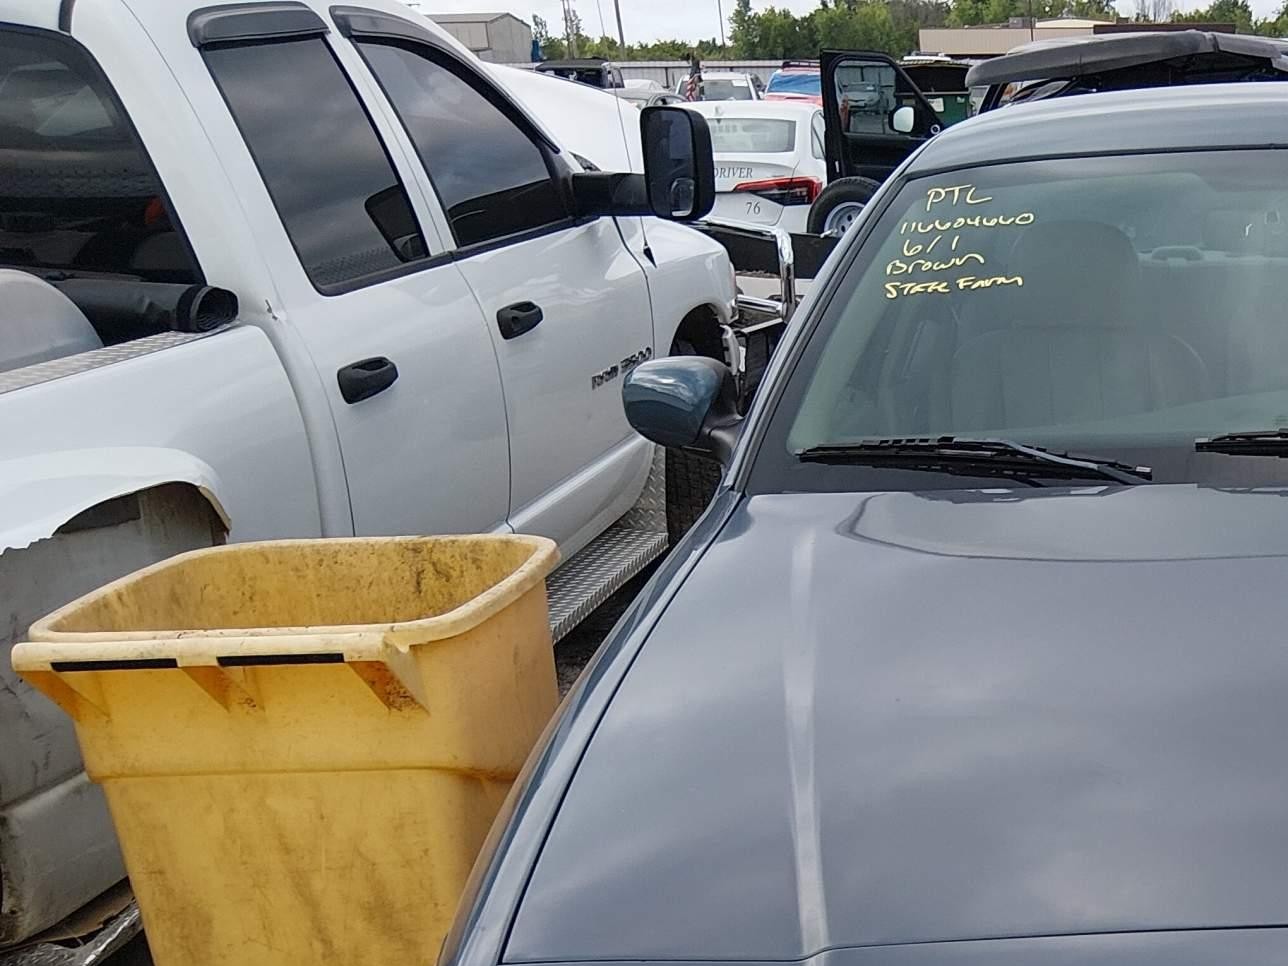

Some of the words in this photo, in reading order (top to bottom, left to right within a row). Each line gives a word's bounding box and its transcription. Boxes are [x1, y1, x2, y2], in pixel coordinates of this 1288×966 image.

[745, 201, 761, 215] 76
[926, 184, 993, 212] PTL
[886, 253, 985, 276] Brown
